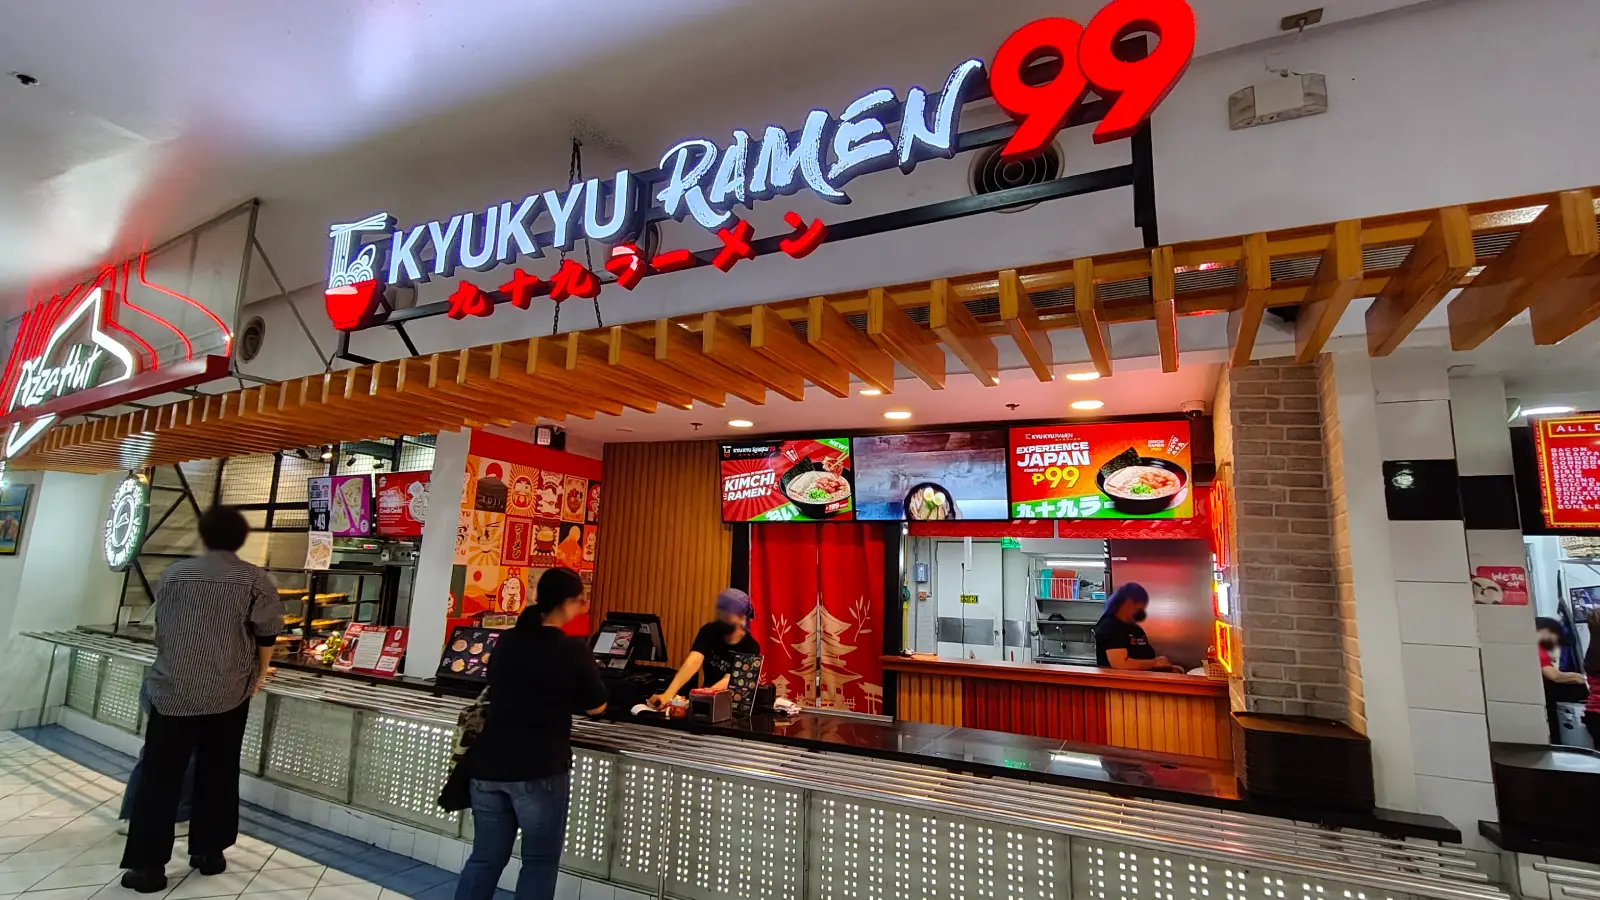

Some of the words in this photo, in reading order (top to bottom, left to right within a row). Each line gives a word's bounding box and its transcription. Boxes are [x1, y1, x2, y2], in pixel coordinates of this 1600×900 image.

[388, 169, 630, 285] KYUKYU
[657, 58, 985, 228] RAMEN
[990, 0, 1196, 159] 99
[447, 211, 829, 320] 九十九ラーメン
[57, 344, 103, 396] Hut
[1556, 424, 1587, 433] ALL
[1016, 441, 1090, 454] EXPERIENCE
[1016, 450, 1091, 467] JAPAN
[724, 471, 776, 492] KIMCHI
